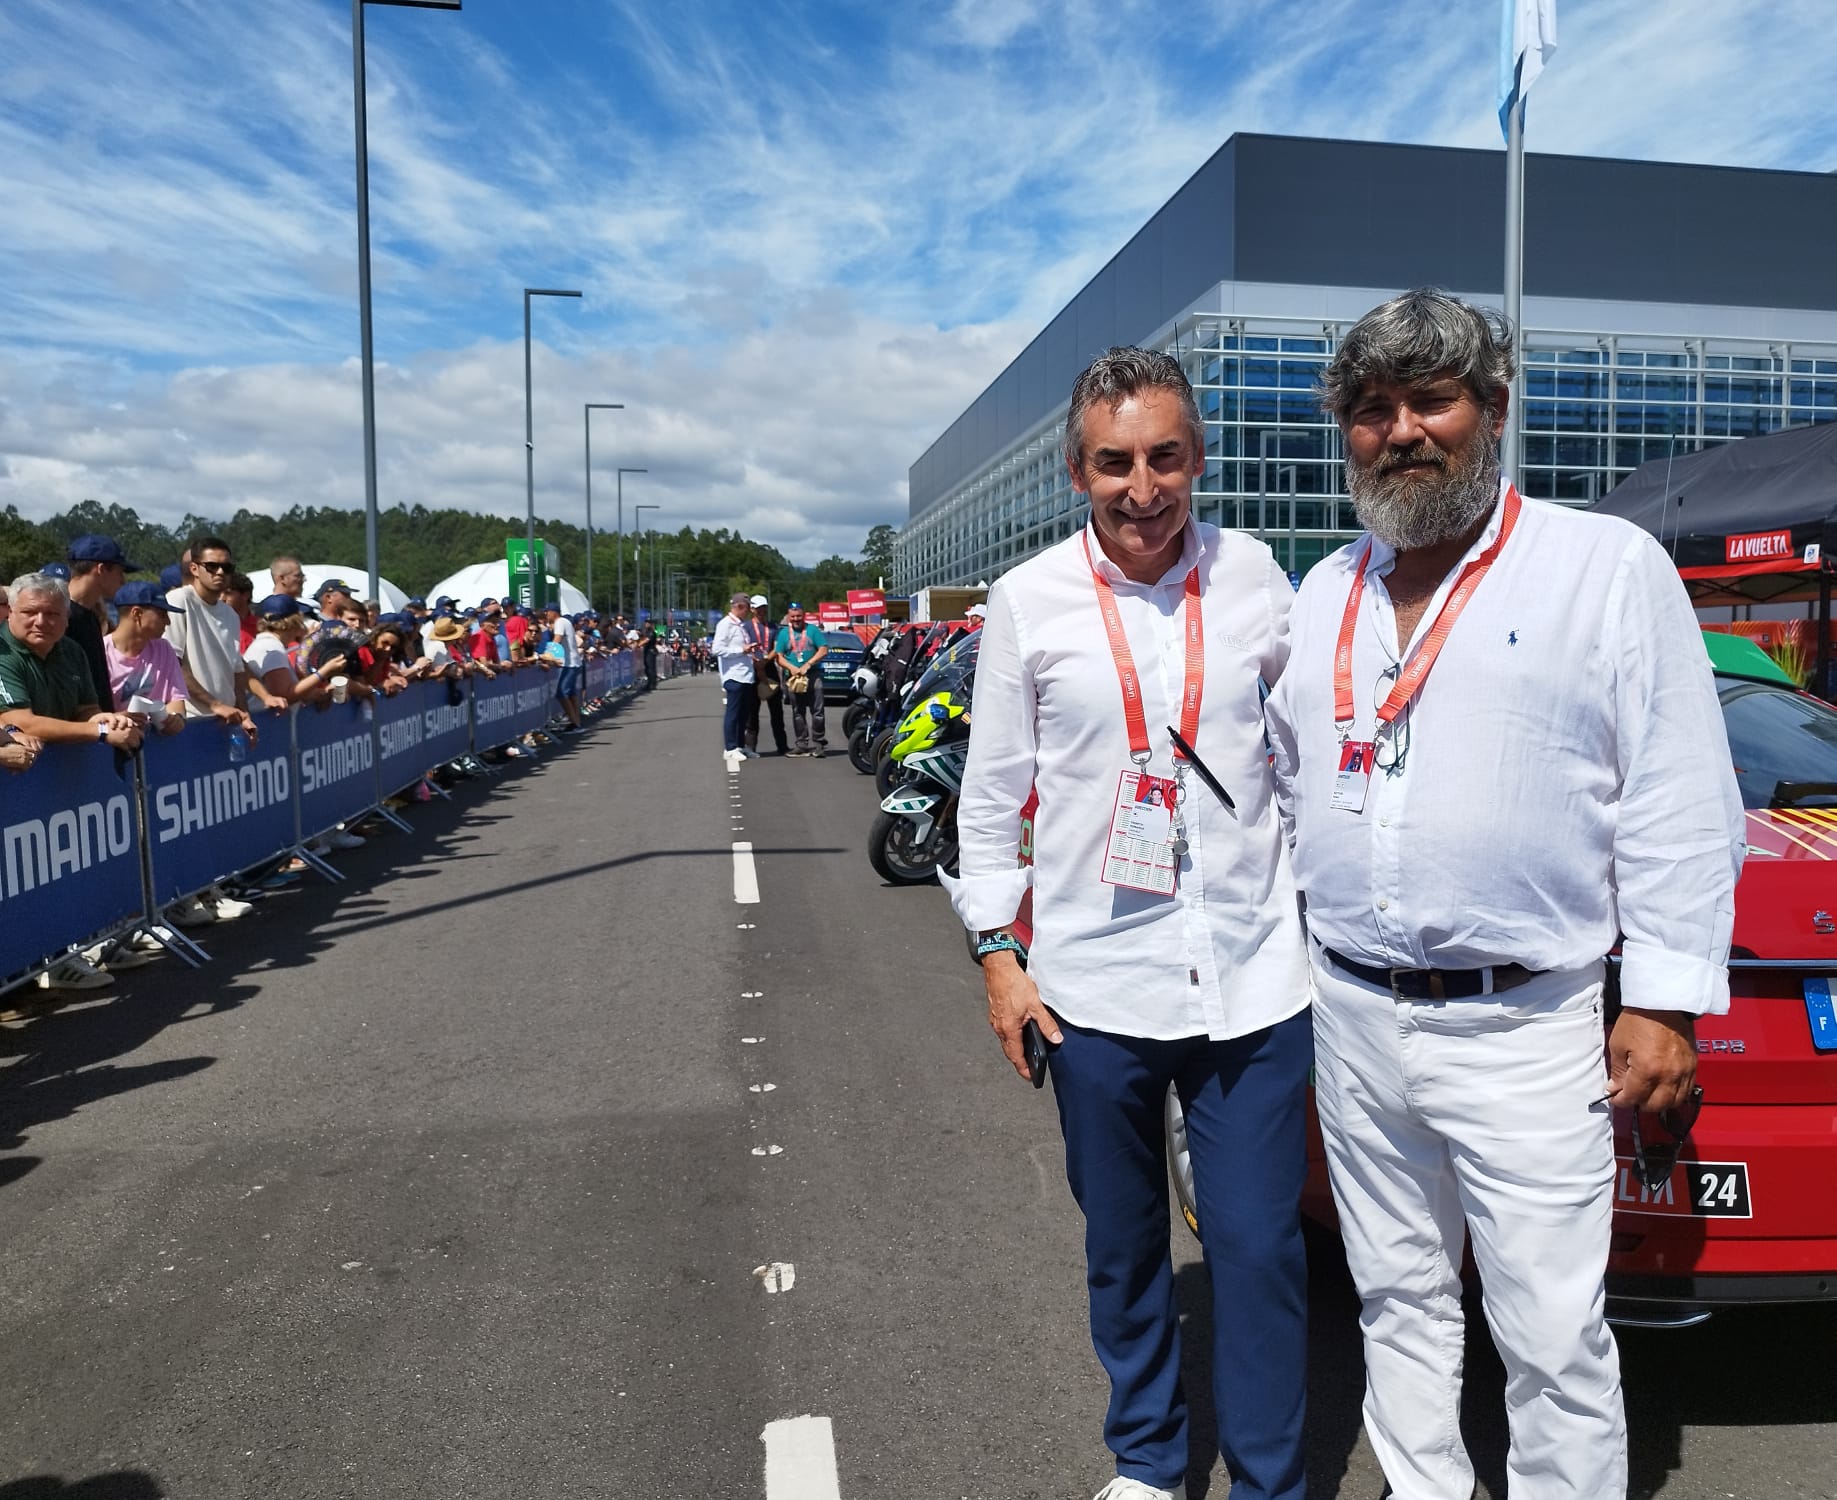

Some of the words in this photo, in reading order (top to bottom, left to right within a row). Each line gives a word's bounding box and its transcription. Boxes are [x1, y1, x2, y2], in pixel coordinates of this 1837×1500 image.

[1730, 540, 1743, 558] LA
[1745, 534, 1788, 556] VUELTA
[380, 714, 422, 760] SHIMANO
[425, 699, 469, 740] SHIMANO
[302, 733, 373, 793] SHIMANO
[156, 756, 289, 843] SHIMANO
[0, 794, 131, 900] MANO
[1819, 1016, 1827, 1031] F
[1698, 1173, 1737, 1207] 24
